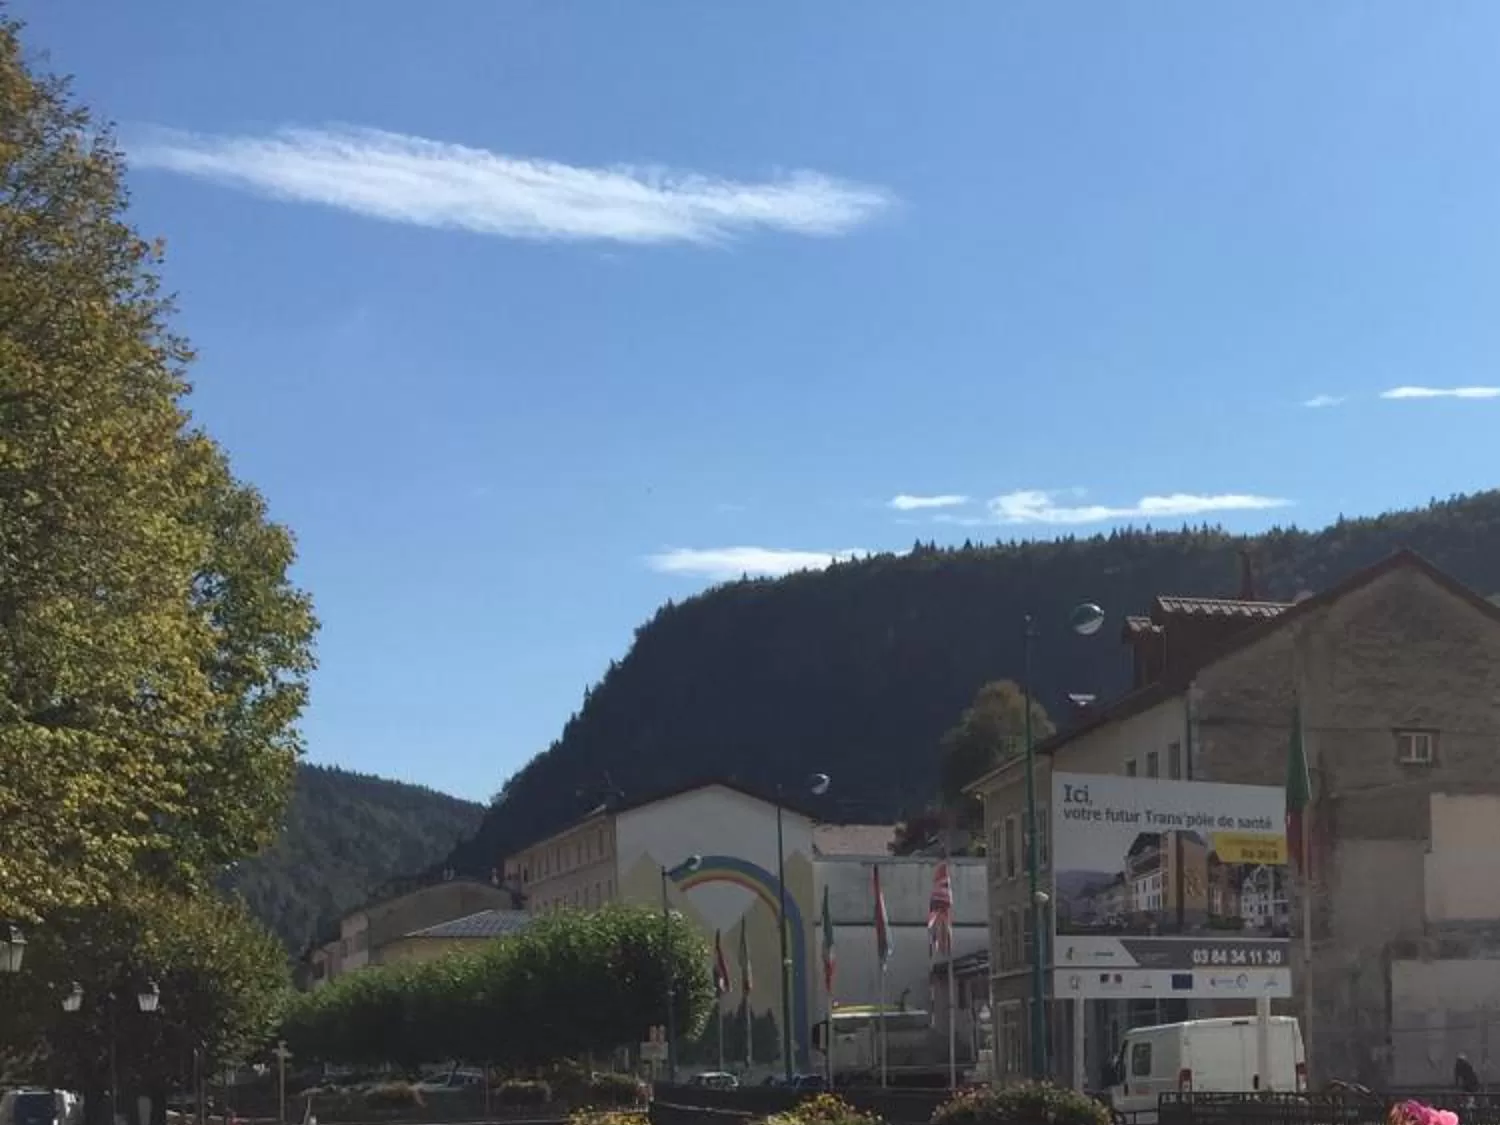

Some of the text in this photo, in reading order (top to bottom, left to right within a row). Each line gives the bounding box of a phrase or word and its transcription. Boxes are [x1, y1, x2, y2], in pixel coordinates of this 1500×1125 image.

[1063, 784, 1093, 806] Ici,
[1063, 806, 1101, 822] votre
[1105, 807, 1140, 824] futur
[1217, 813, 1234, 827] de
[1238, 815, 1273, 829] santé
[1193, 949, 1209, 964] 03
[1249, 949, 1262, 965] 11
[1266, 949, 1281, 965] 30
